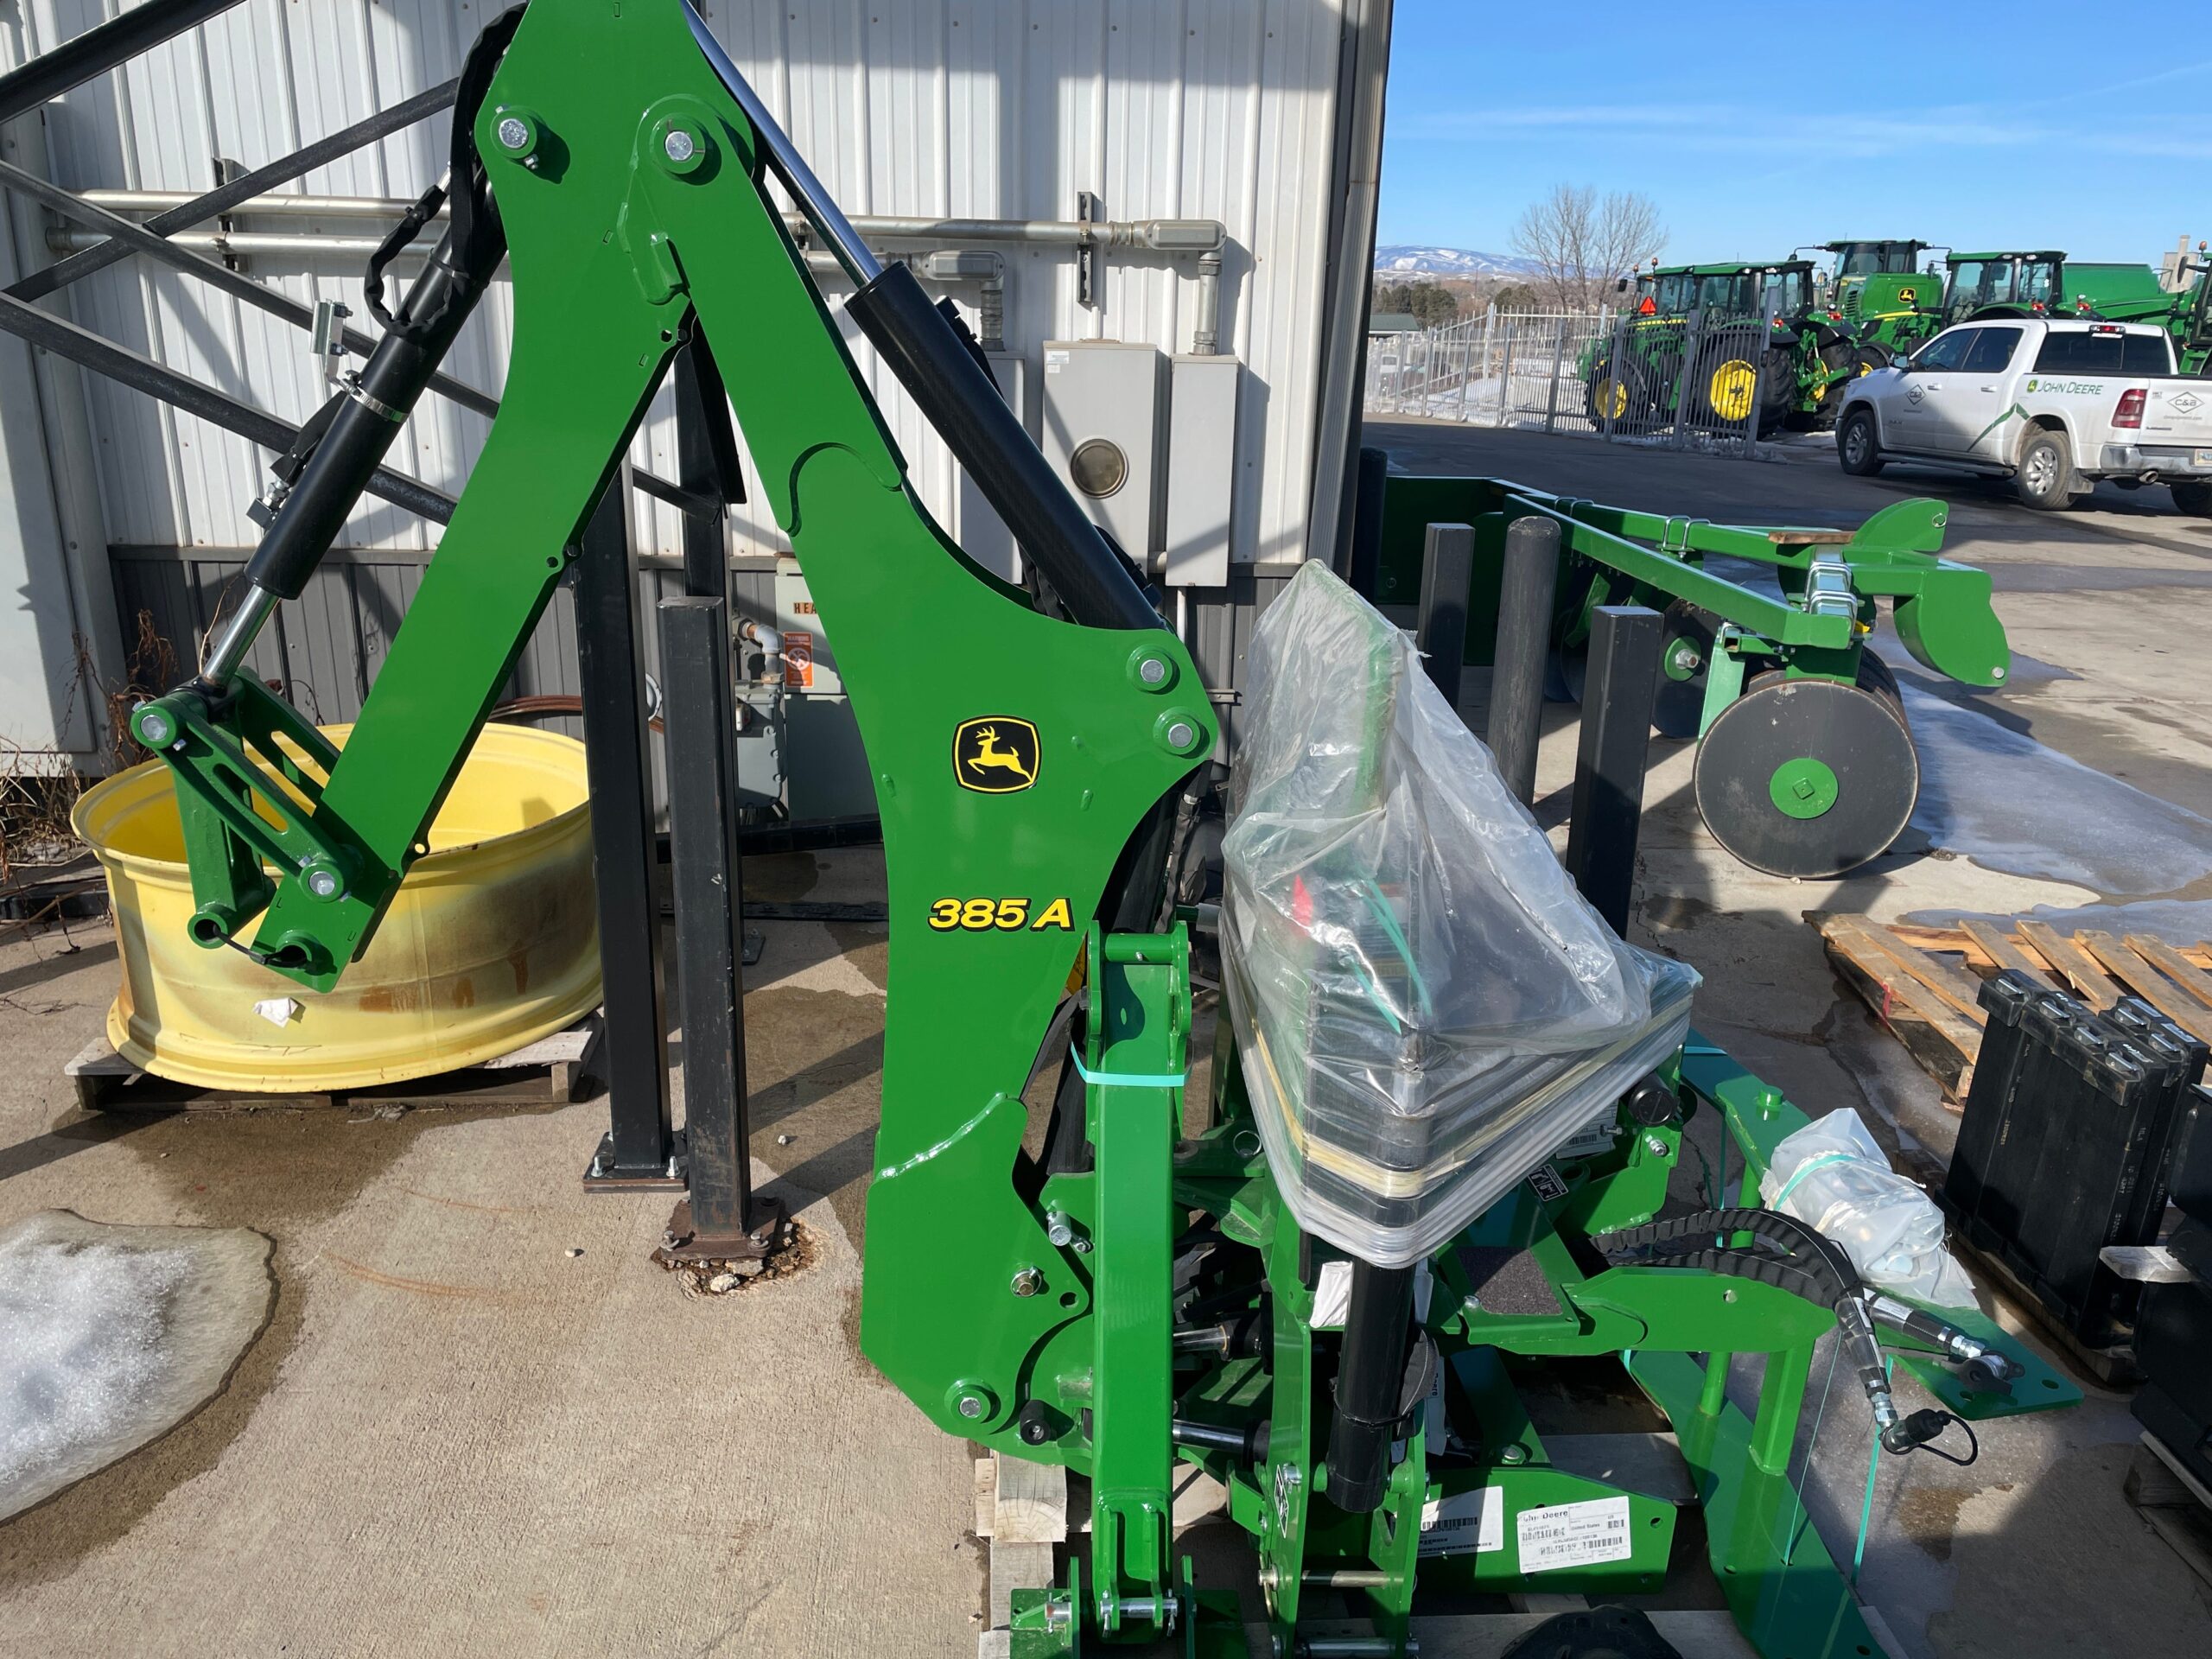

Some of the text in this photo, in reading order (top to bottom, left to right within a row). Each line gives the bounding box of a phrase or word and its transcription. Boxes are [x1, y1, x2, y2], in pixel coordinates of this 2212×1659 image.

[2037, 380, 2103, 395] JOHN DEERE
[793, 602, 817, 614] HEA
[928, 898, 1076, 932] 385 A
[1542, 1510, 1568, 1519] Deere
